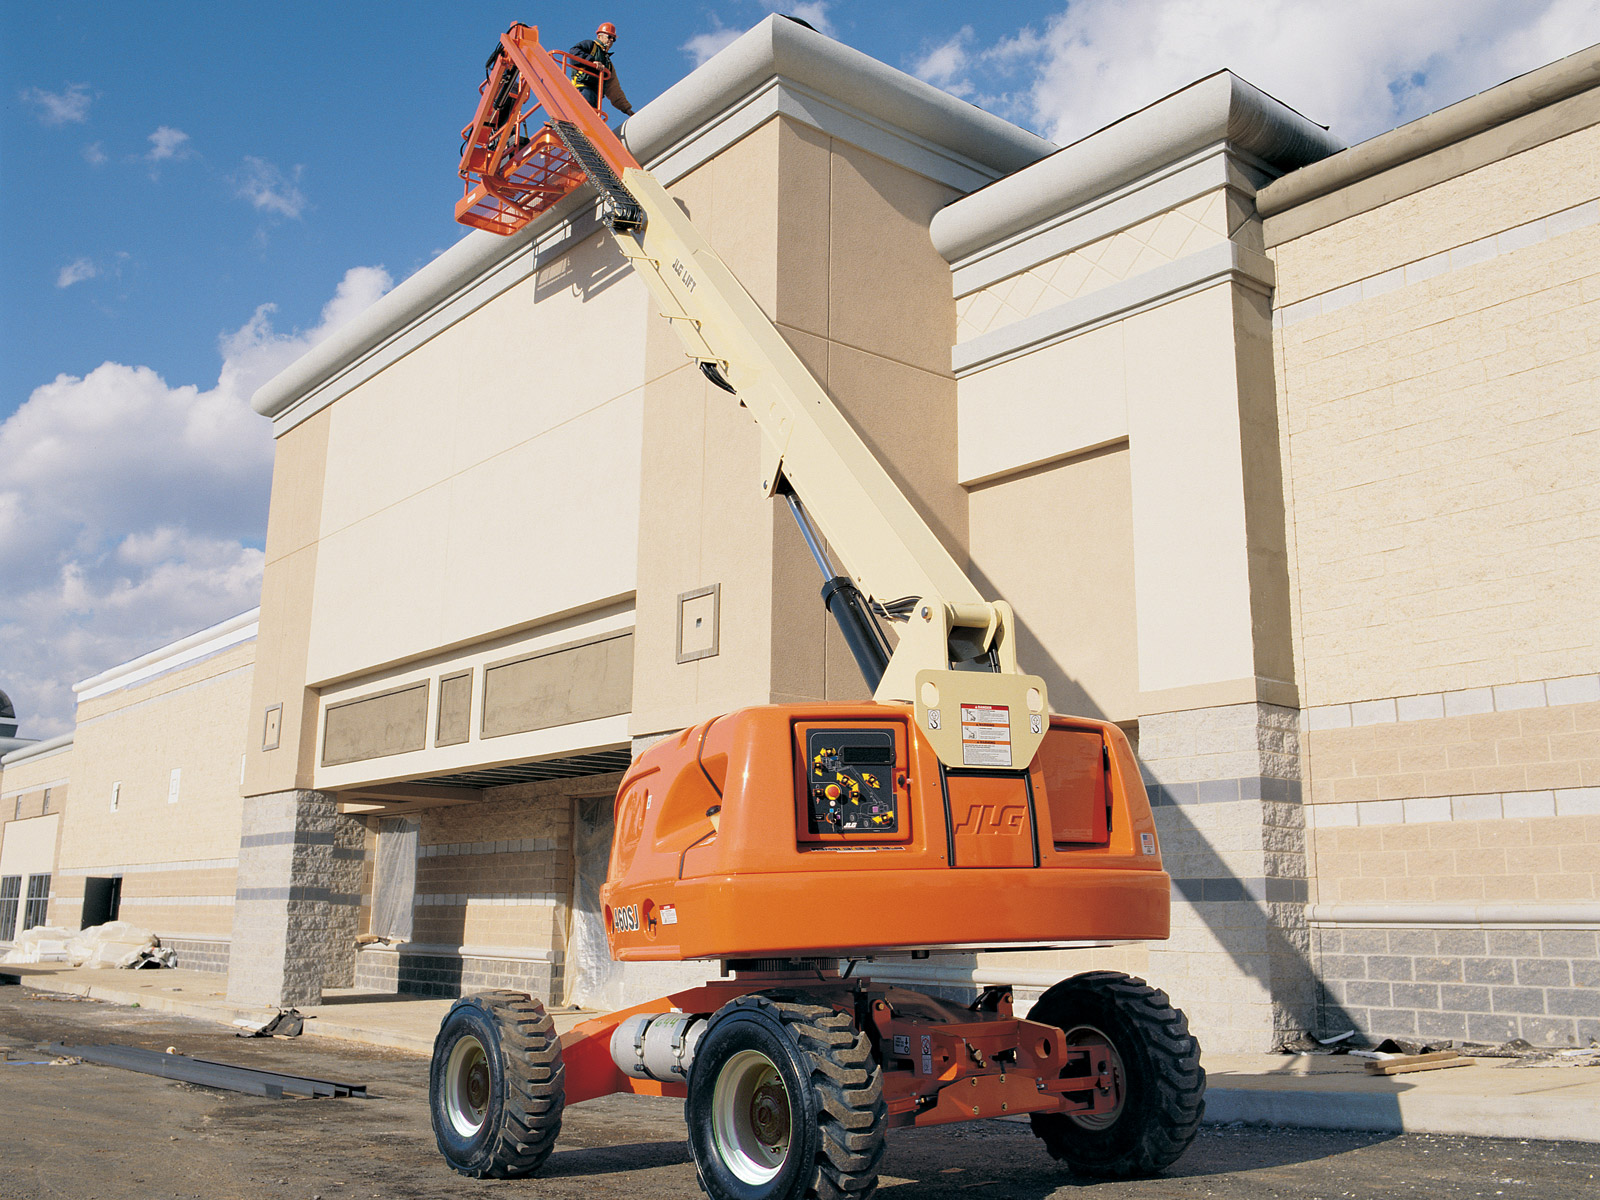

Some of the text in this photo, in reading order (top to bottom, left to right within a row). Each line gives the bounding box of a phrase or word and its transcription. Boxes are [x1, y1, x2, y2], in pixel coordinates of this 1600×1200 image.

[672, 258, 697, 293] JLG LIFT
[954, 804, 1027, 836] JLG
[613, 904, 639, 933] 460SJ
